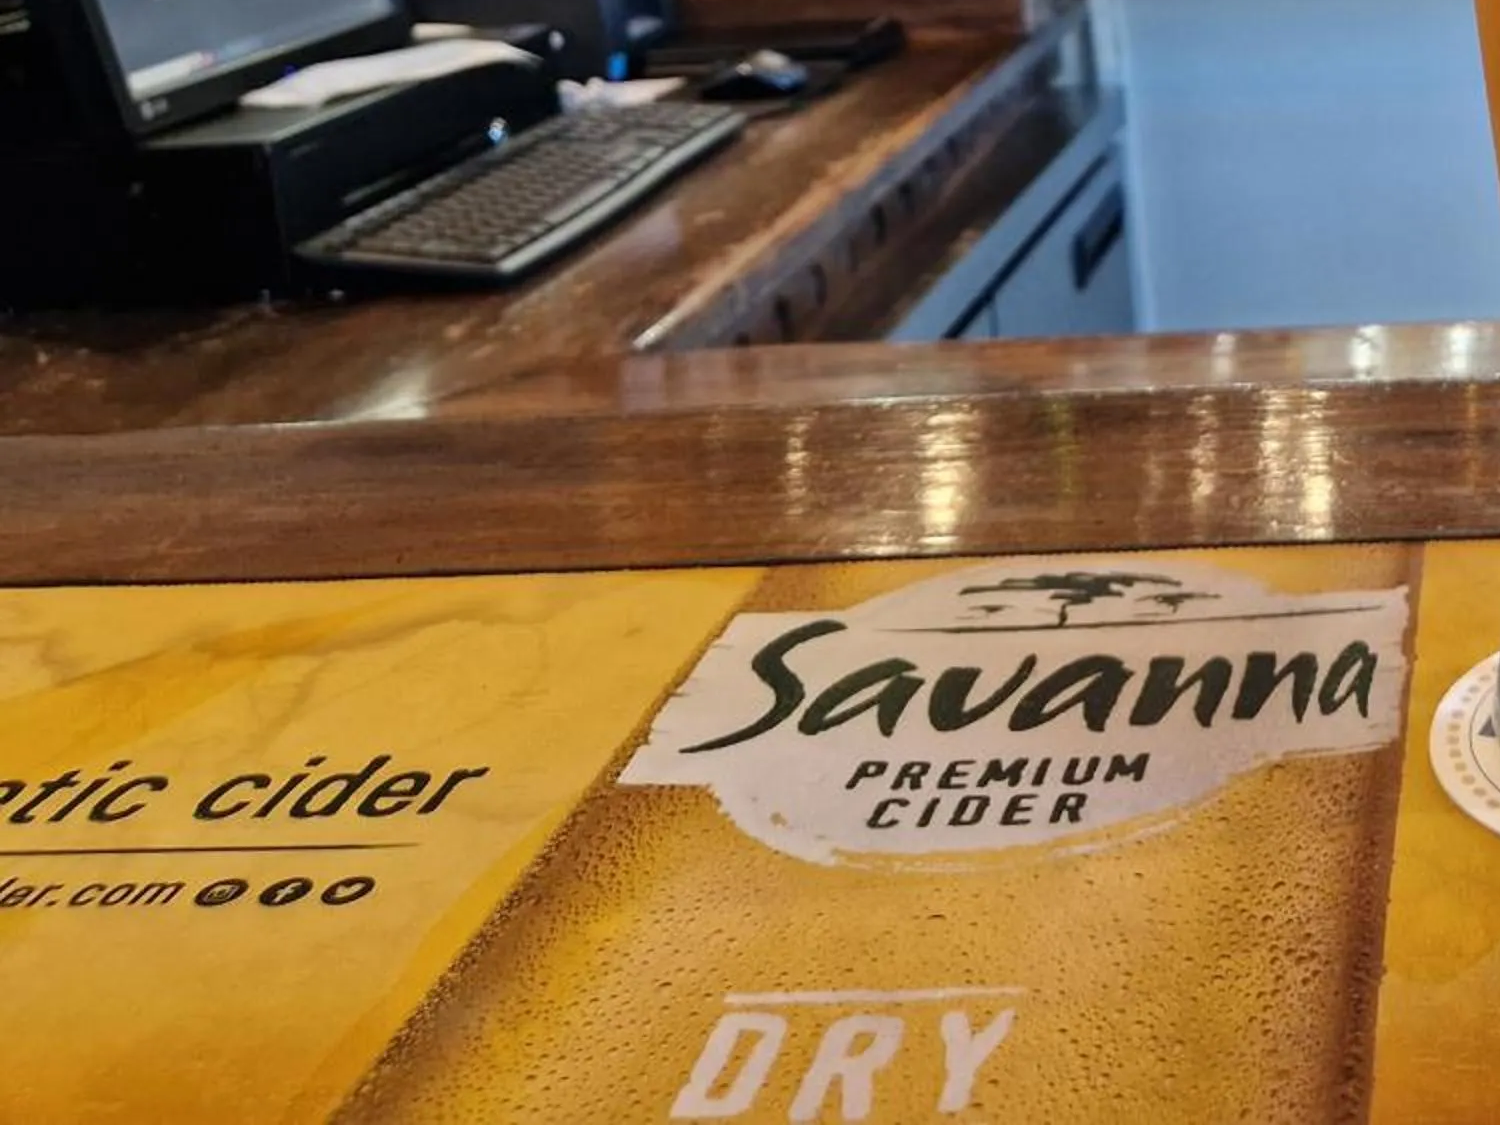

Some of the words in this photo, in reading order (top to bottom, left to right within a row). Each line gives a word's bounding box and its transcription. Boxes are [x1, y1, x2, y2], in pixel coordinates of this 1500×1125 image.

[678, 619, 1379, 754] Savanna
[192, 754, 491, 820] cider
[845, 752, 1150, 790] PREMIUM
[865, 792, 1087, 828] CIDER
[669, 1007, 1017, 1123] DRY
